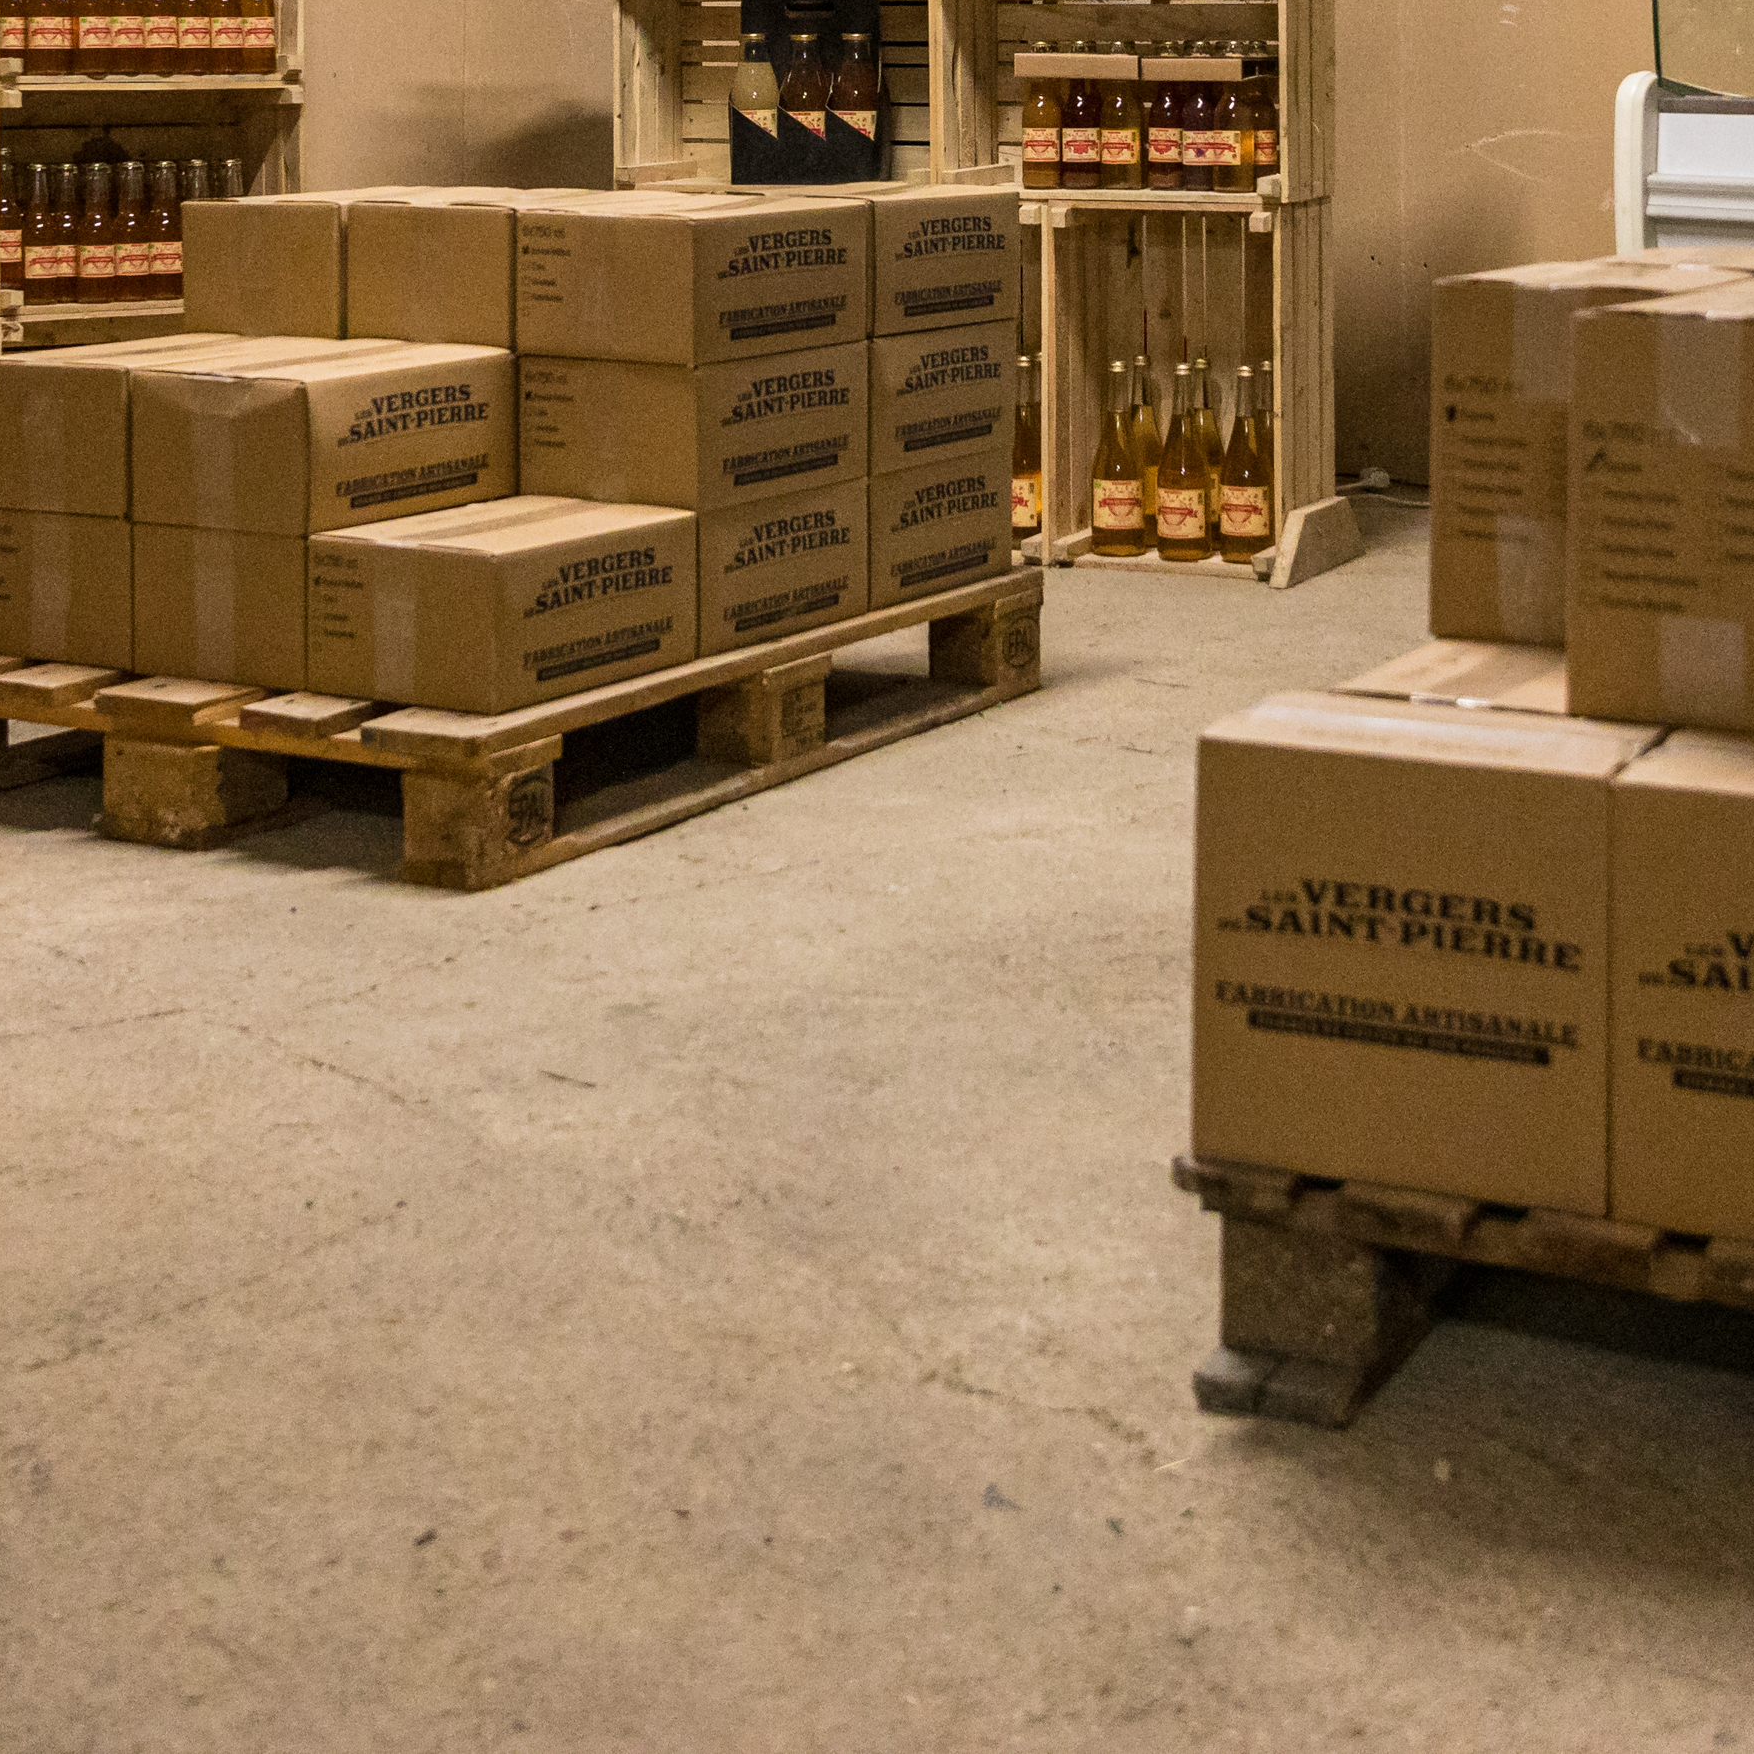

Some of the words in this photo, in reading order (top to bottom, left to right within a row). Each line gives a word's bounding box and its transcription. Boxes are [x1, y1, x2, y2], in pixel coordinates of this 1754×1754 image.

[748, 229, 832, 253] VERGERS
[919, 216, 992, 237] VERGERS
[920, 345, 989, 369] VERGERS
[751, 369, 835, 397] VERGERS
[372, 384, 471, 415] VERGERS
[754, 509, 836, 542] VERGERS
[559, 547, 655, 584] VERGERS
[1300, 878, 1536, 932] VERGERS
